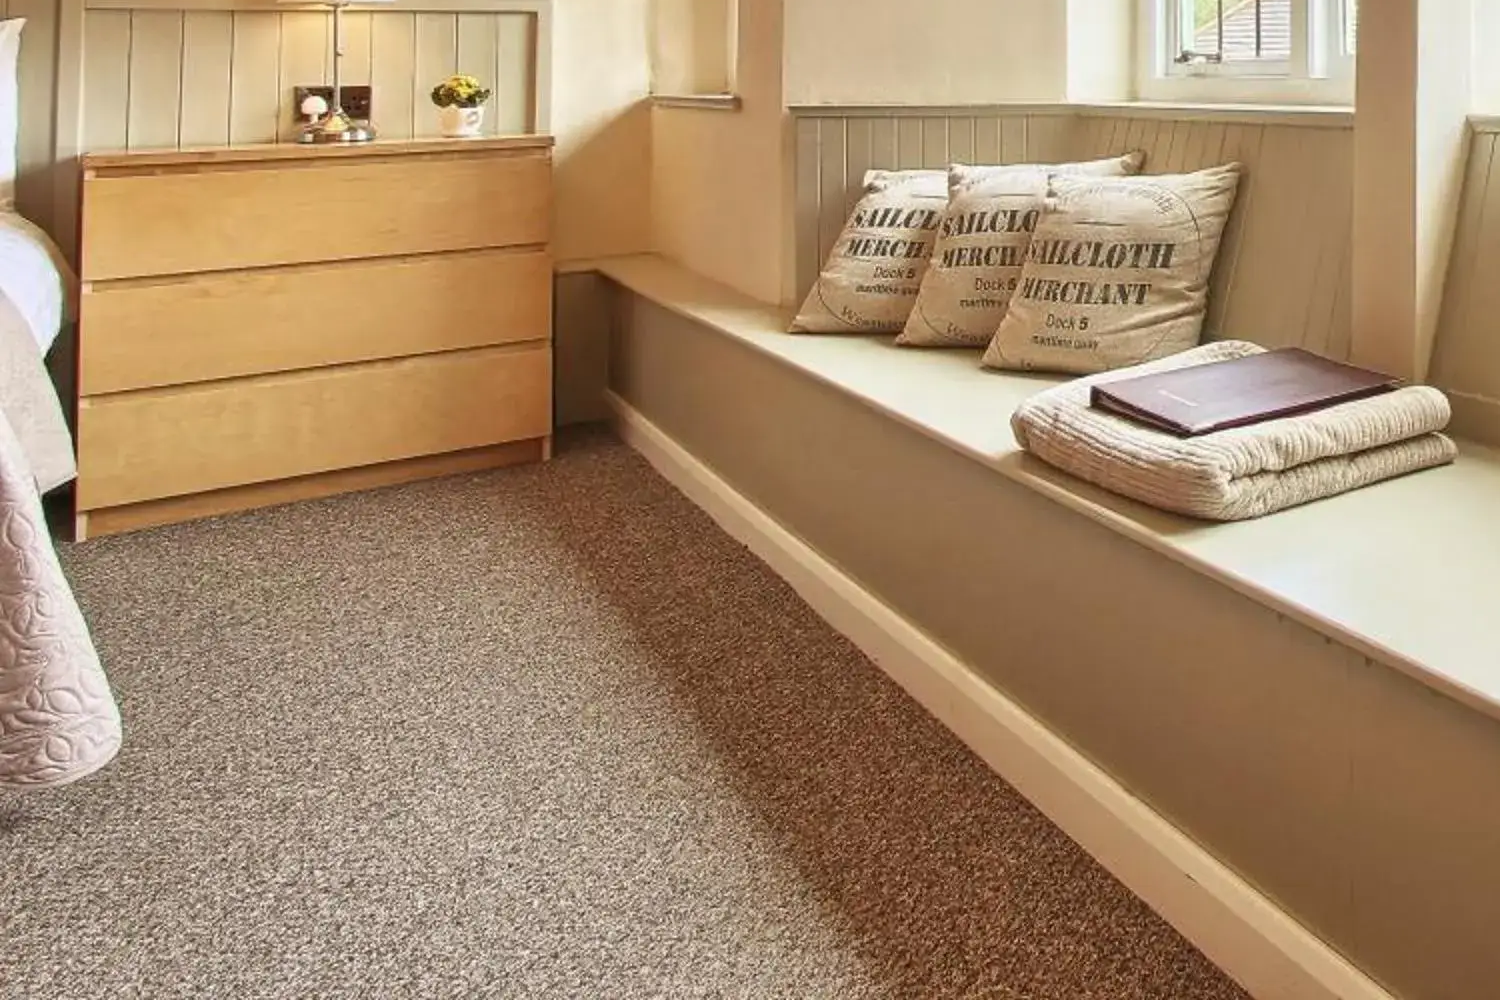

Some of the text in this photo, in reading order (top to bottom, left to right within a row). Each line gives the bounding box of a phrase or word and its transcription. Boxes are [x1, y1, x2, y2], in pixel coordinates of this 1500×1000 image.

[850, 207, 941, 230] SAILCL
[844, 238, 933, 259] MERCH
[940, 245, 1028, 268] MERCH
[873, 265, 902, 279] Dock
[975, 277, 1004, 291] Dock
[1022, 277, 1152, 305] MERCHANT
[1046, 313, 1089, 331] Dock 5
